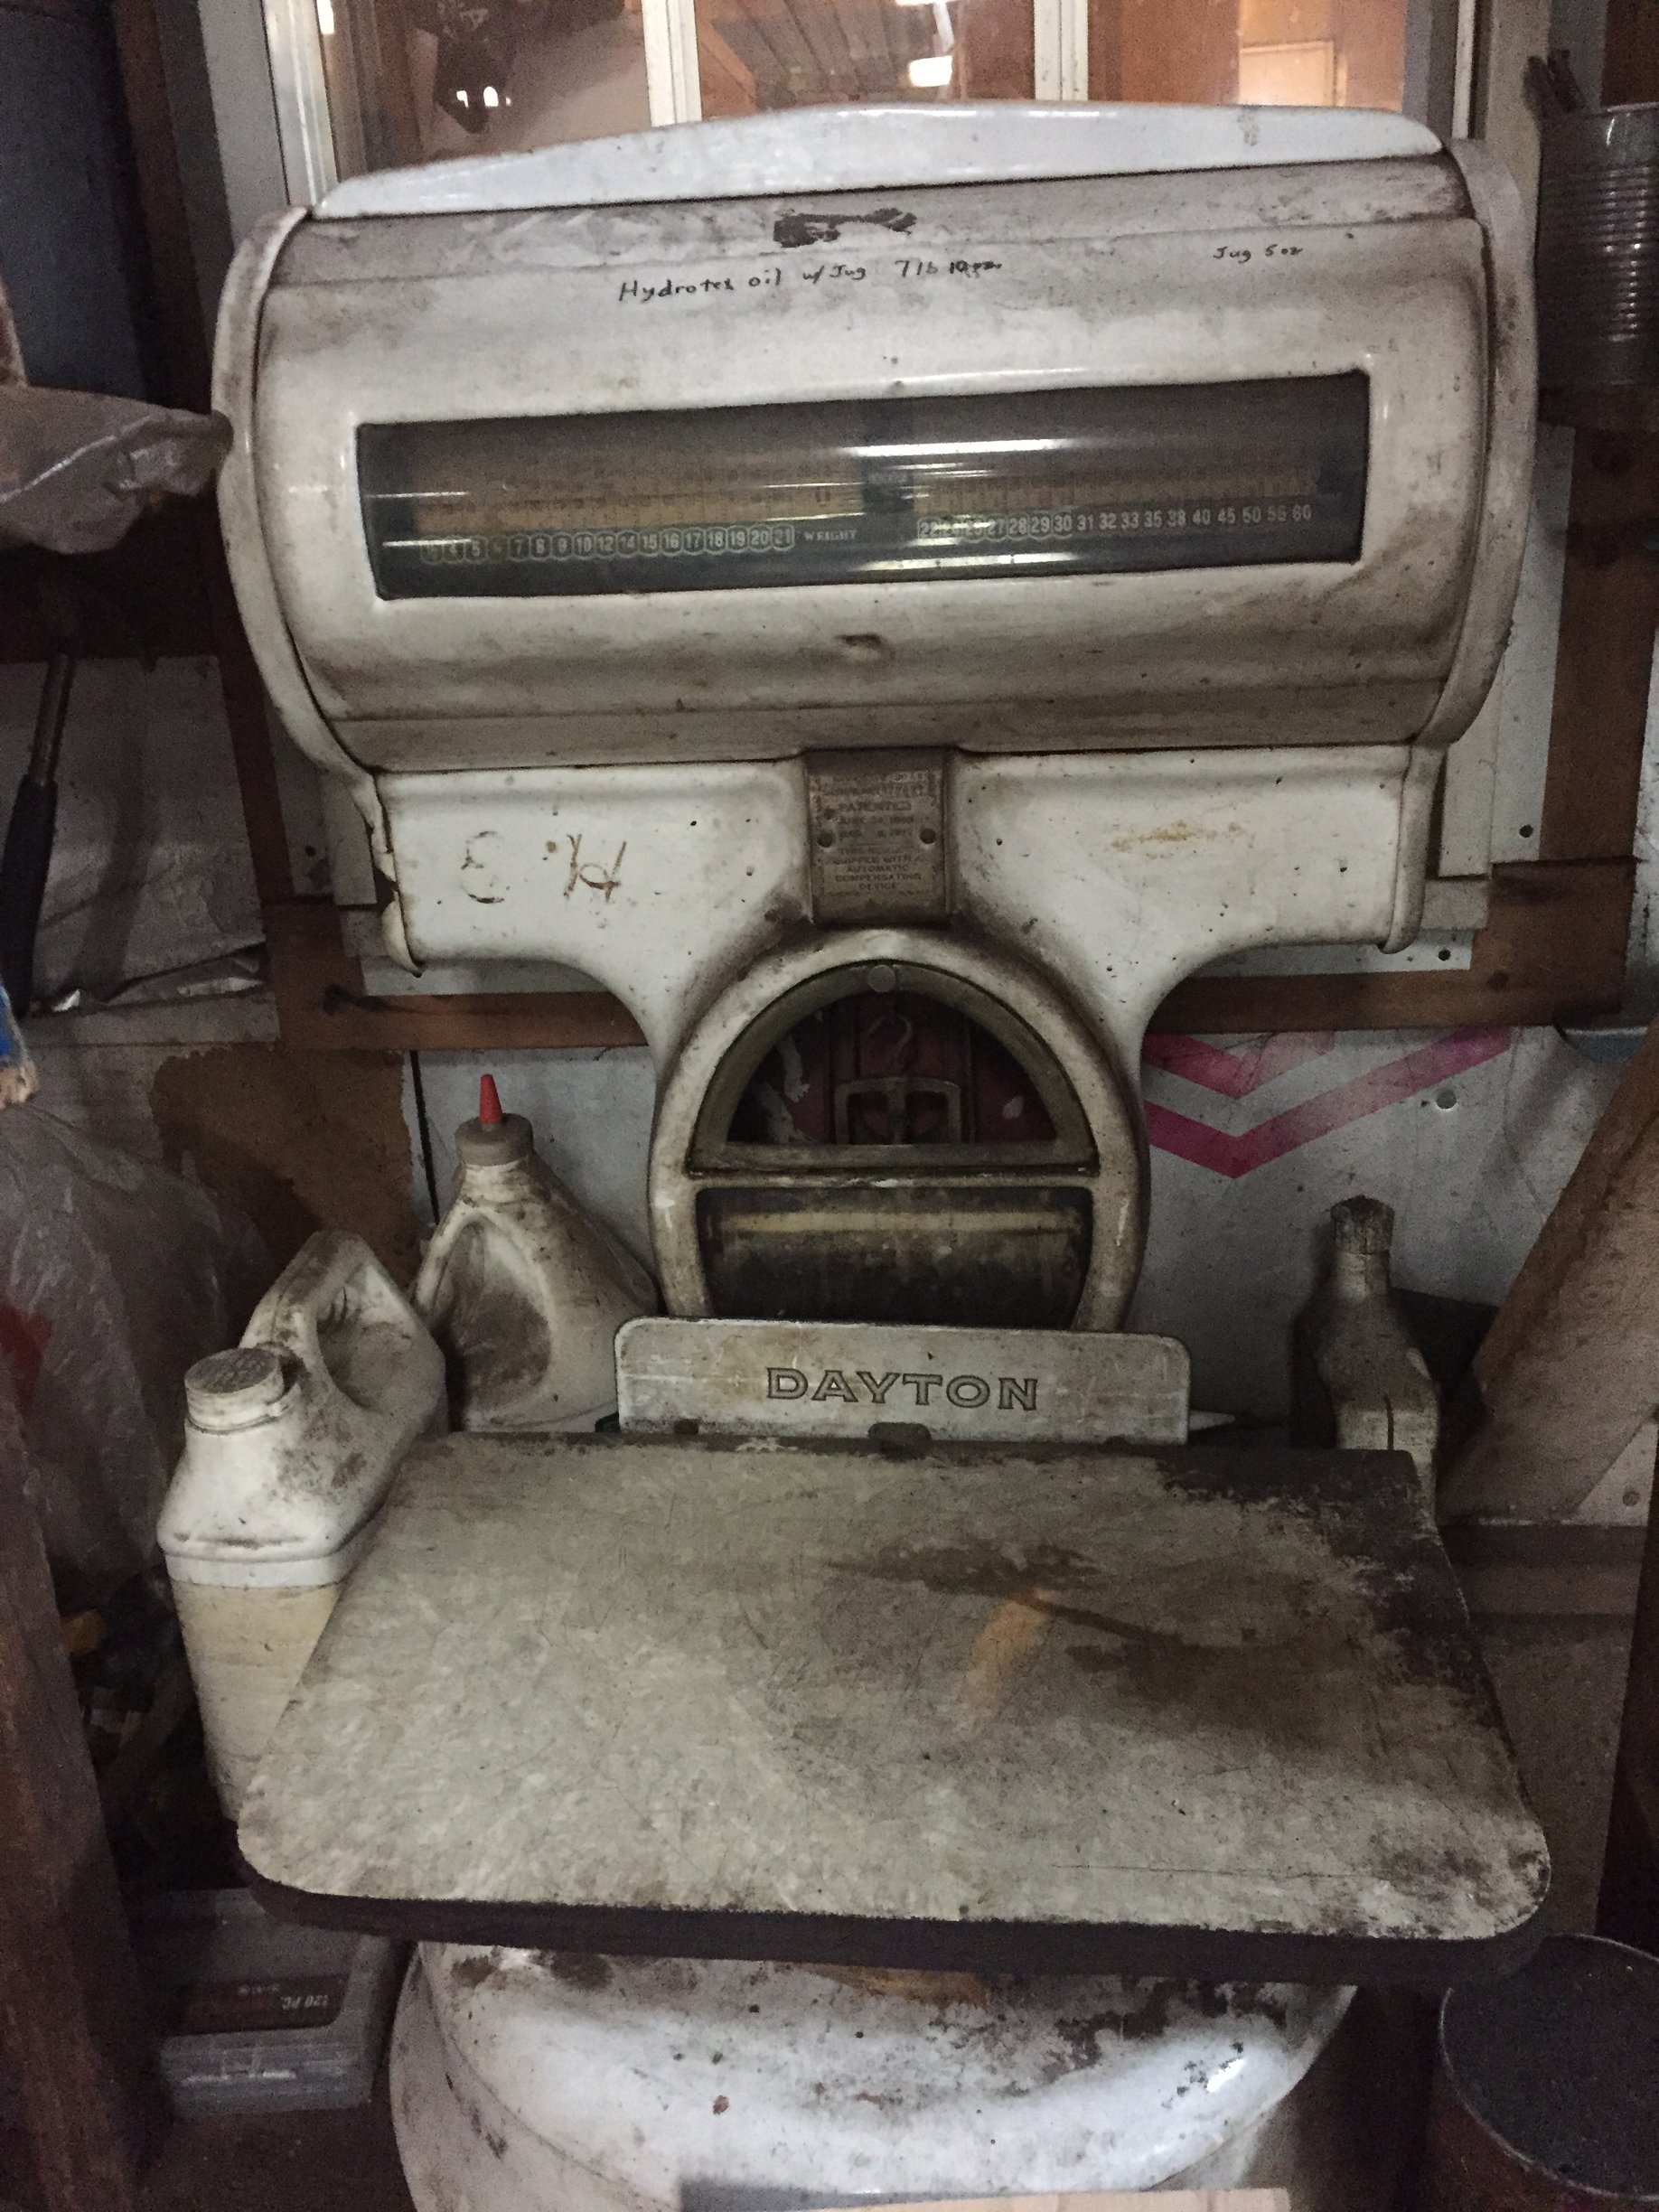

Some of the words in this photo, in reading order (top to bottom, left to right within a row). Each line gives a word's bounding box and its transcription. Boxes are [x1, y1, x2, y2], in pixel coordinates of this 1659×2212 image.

[1213, 246, 1251, 263] Jug
[619, 279, 734, 304] Hydrotex
[748, 267, 783, 287] oil
[802, 265, 824, 285] w/
[830, 264, 866, 281] Jug
[987, 518, 1005, 535] 27
[1009, 517, 1027, 534] 28
[1031, 516, 1049, 533] 29
[1054, 515, 1073, 532] 30
[1076, 514, 1093, 531] 31
[1098, 512, 1117, 530] 32
[1120, 511, 1139, 529] 33
[1143, 509, 1163, 528] 35
[1167, 508, 1186, 526] 38
[1193, 507, 1211, 525] 40
[1217, 506, 1236, 524] 45
[1242, 504, 1261, 523] 50
[536, 538, 545, 555] 8
[558, 537, 568, 554] 9
[576, 536, 593, 553] 10
[597, 535, 614, 552] 12
[642, 533, 658, 549] 15
[663, 533, 680, 549] 16
[685, 532, 702, 548] 17
[708, 531, 723, 548] 18
[729, 530, 745, 548] 19
[750, 530, 770, 546] 20
[774, 529, 792, 545] 21
[803, 529, 858, 541] WEIGHT
[835, 873, 923, 883] COMPENSATING
[847, 864, 910, 873] AUTOMATIC
[766, 1367, 1038, 1411] DAYTON
